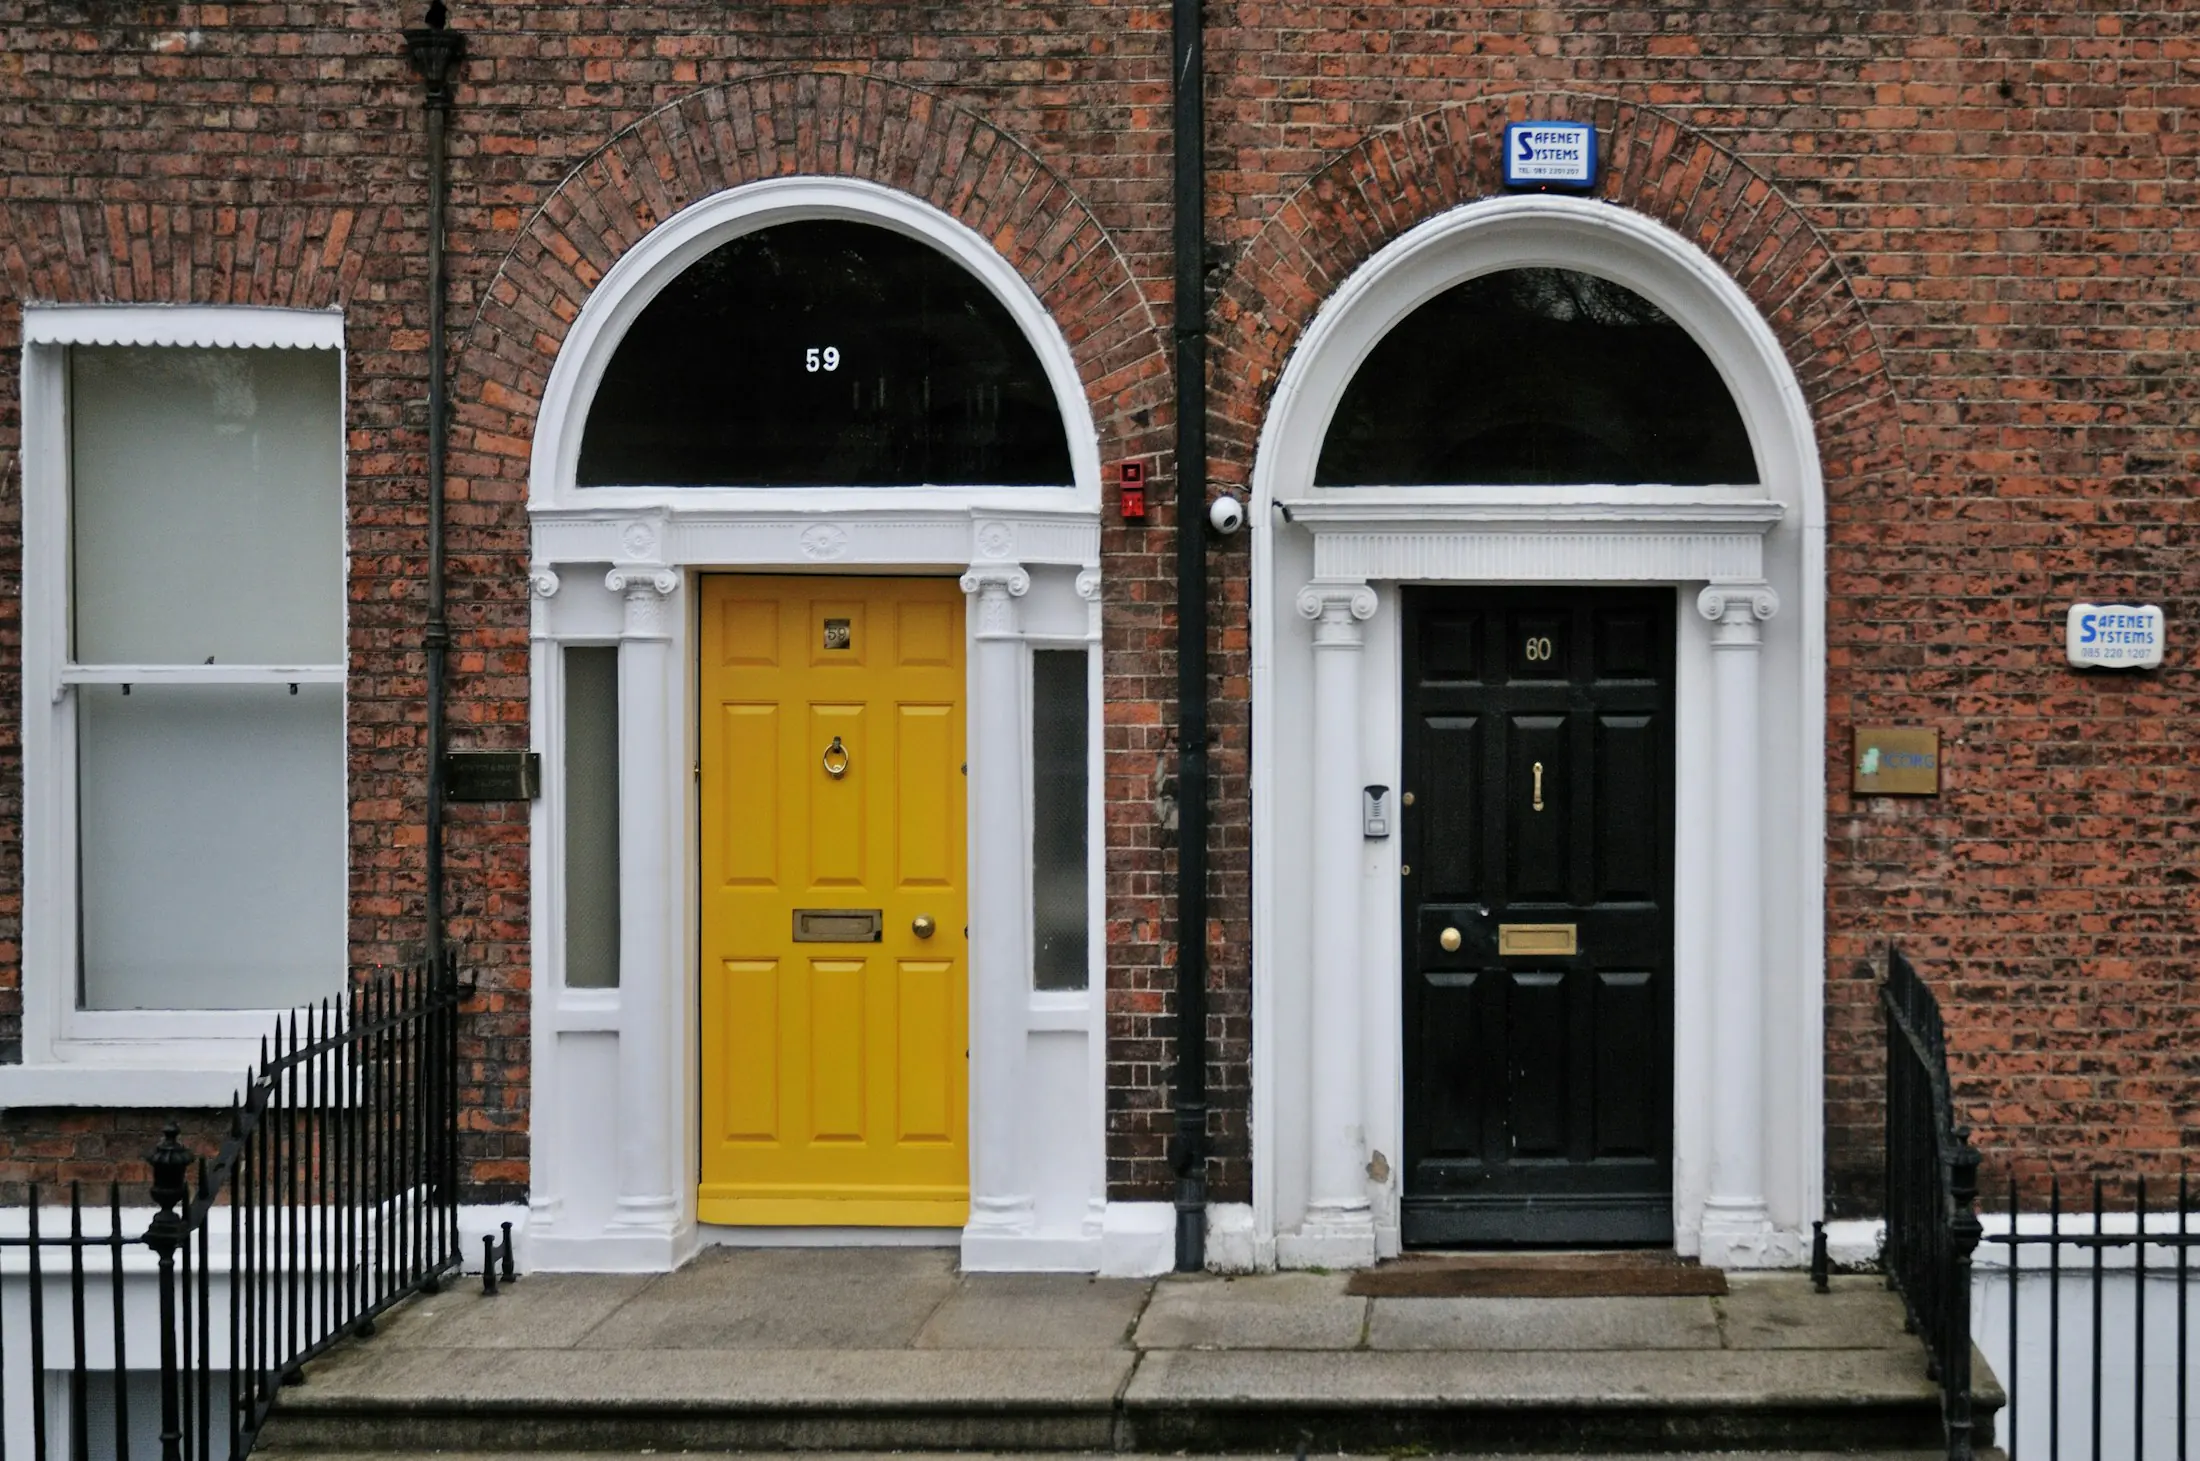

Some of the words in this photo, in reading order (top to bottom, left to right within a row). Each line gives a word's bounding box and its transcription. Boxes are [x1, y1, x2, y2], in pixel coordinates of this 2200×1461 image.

[1518, 132, 1580, 147] SAFENET
[806, 346, 840, 373] 59
[2080, 615, 2153, 630] SAFENET
[828, 627, 846, 641] 59
[1526, 637, 1551, 660] 60
[2081, 648, 2100, 658] 085
[2104, 648, 2123, 658] 220
[2128, 649, 2152, 658] 1207
